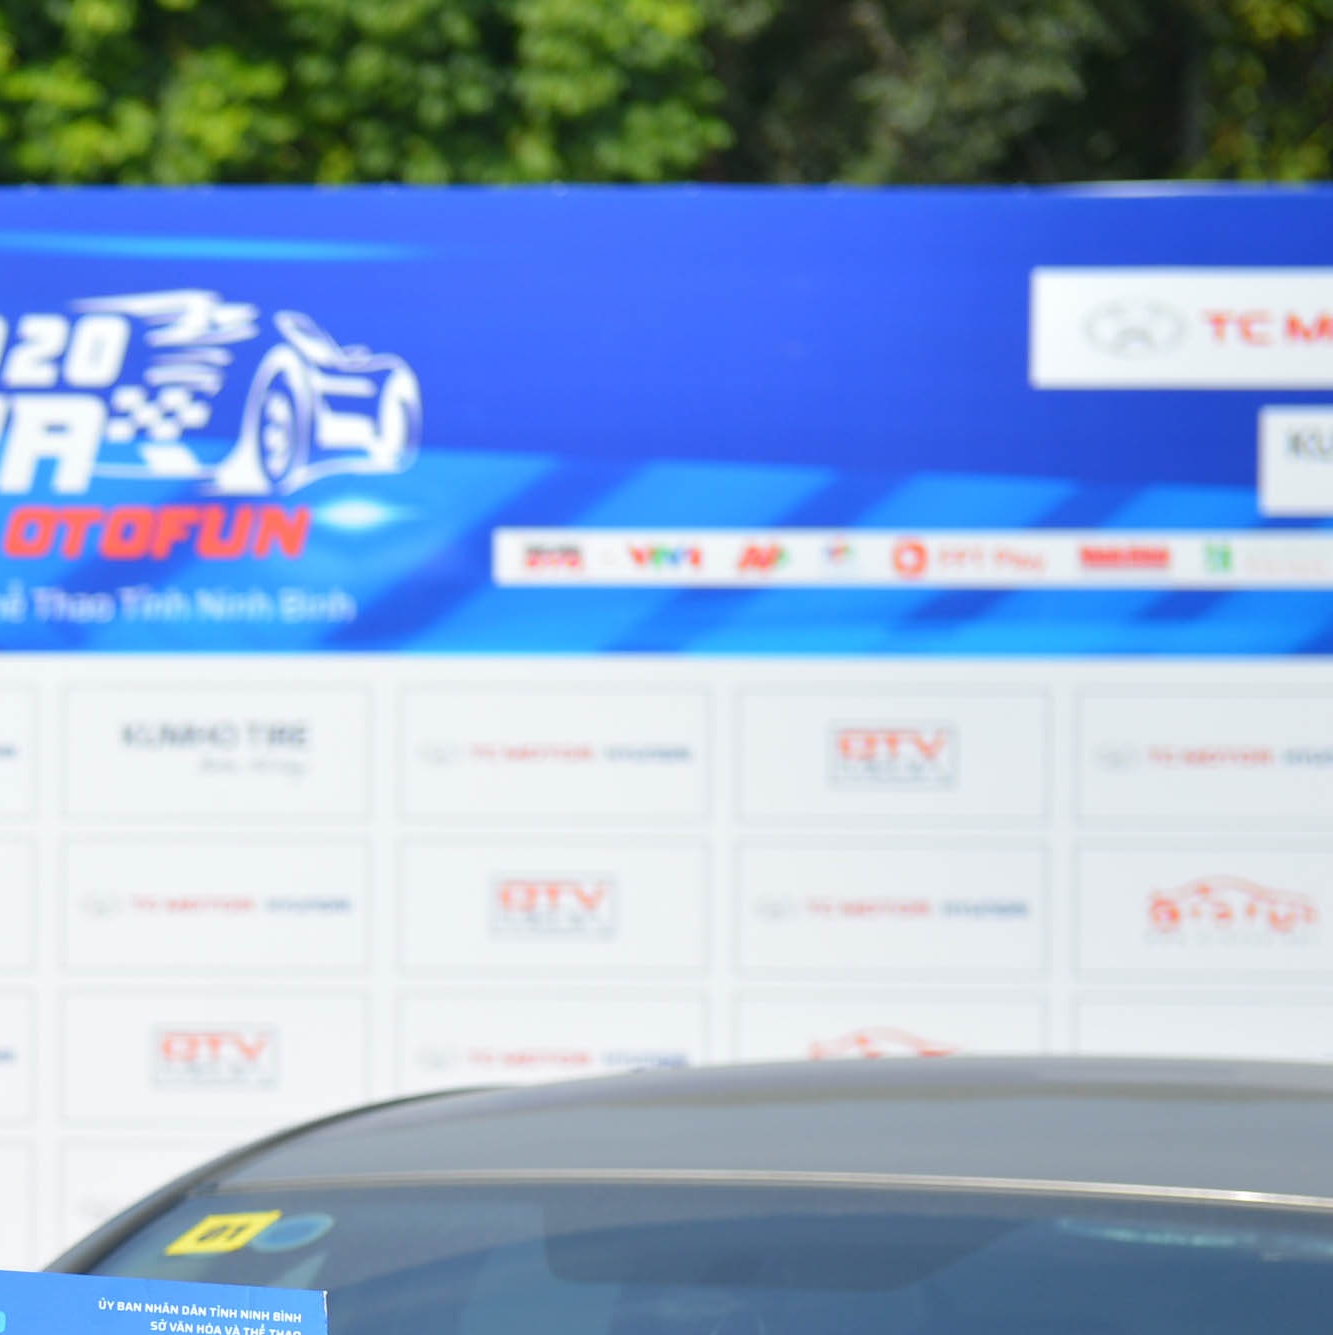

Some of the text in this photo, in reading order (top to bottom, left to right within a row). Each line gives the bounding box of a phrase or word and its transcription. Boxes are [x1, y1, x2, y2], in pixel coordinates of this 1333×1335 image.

[3, 505, 312, 559] OTOFUN
[99, 1297, 302, 1323] ỦY BAN NHÂN DÂN TỈNH NINH BÌNH
[150, 1317, 167, 1331] SỞ
[169, 1319, 194, 1333] VĂN
[197, 1320, 222, 1335] HÓA
